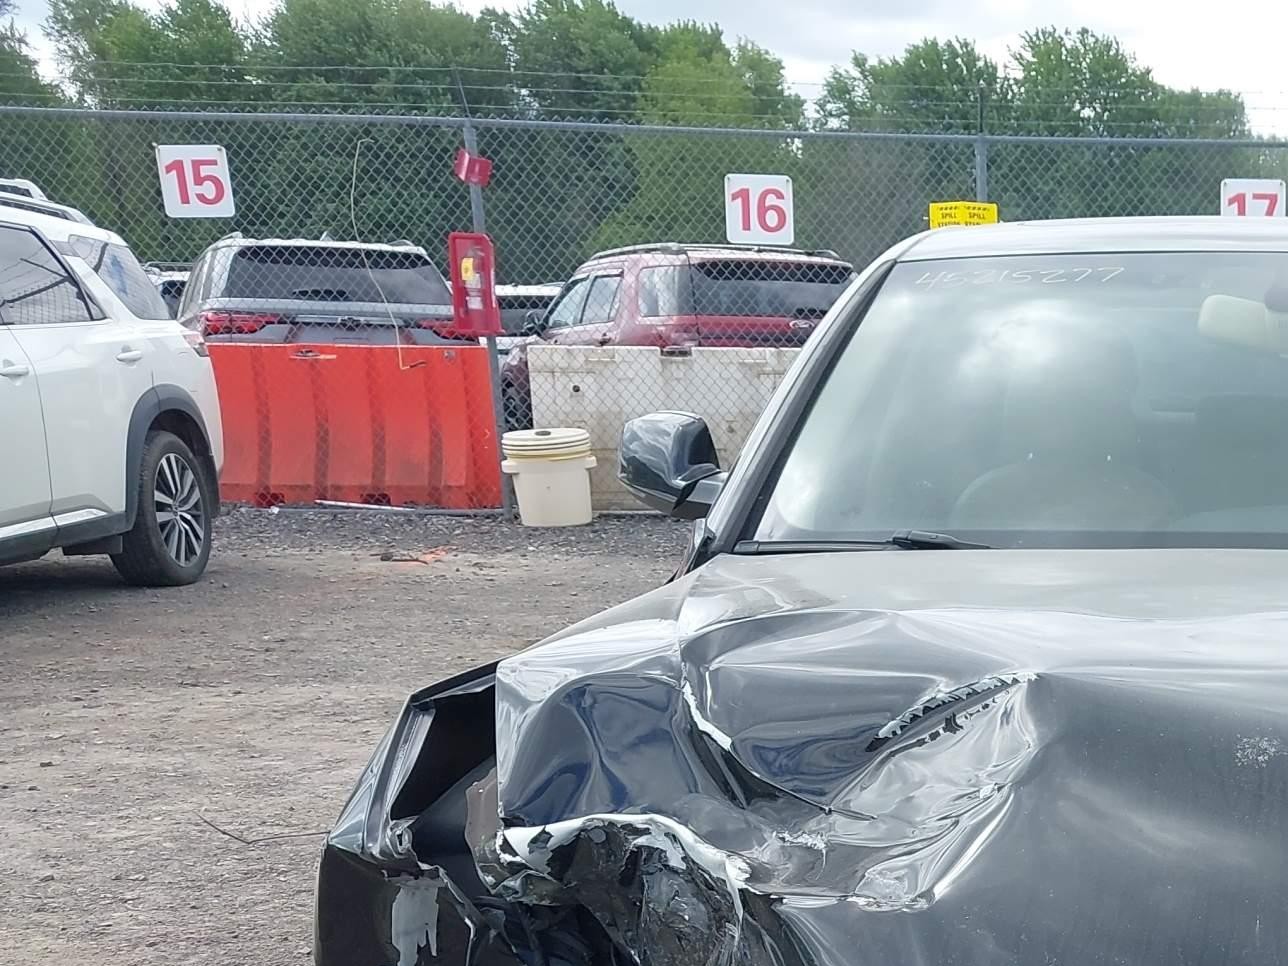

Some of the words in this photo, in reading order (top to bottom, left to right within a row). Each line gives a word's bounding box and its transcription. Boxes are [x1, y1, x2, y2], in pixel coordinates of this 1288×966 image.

[164, 159, 225, 205] 15
[730, 187, 787, 233] 16
[915, 267, 1125, 289] 45215277
